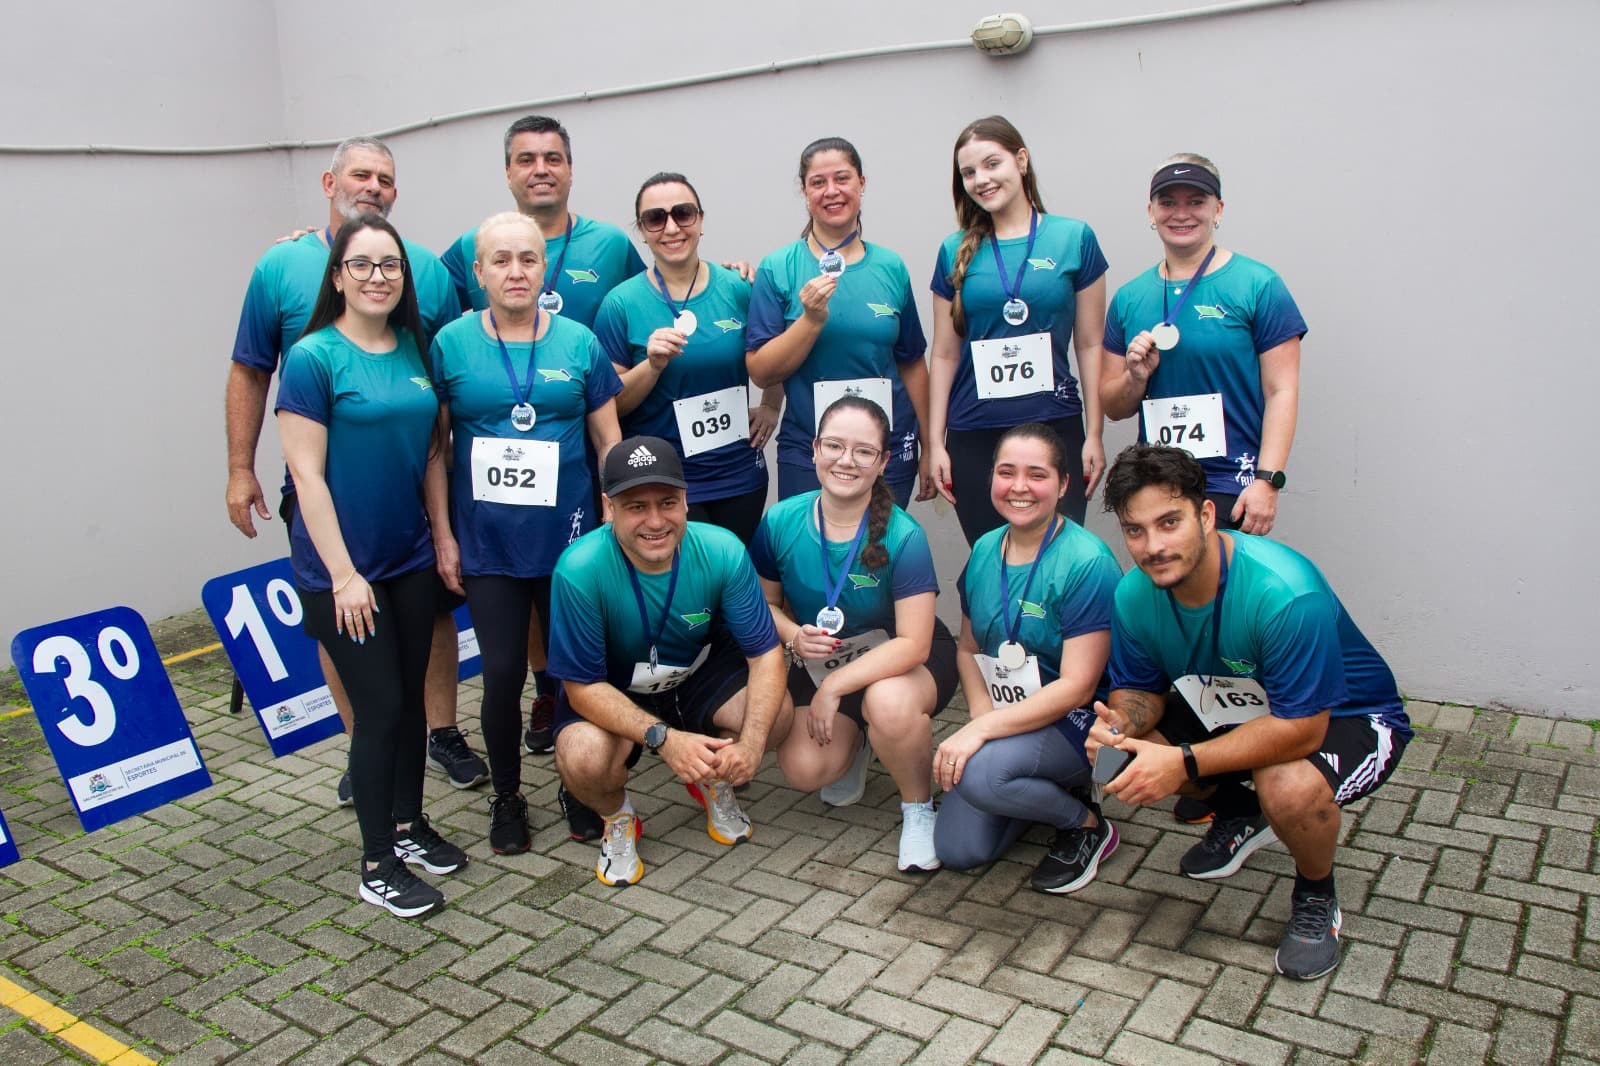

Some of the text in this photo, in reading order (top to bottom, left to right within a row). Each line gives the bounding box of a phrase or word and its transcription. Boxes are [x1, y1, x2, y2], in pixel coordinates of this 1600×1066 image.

[990, 361, 1034, 383] 076
[691, 413, 731, 438] 039
[1160, 422, 1205, 445] 074
[487, 466, 536, 489] 052
[991, 683, 1027, 703] 008
[1214, 692, 1264, 709] 163
[1066, 711, 1087, 730] RUN
[127, 767, 158, 782] ESPORTES
